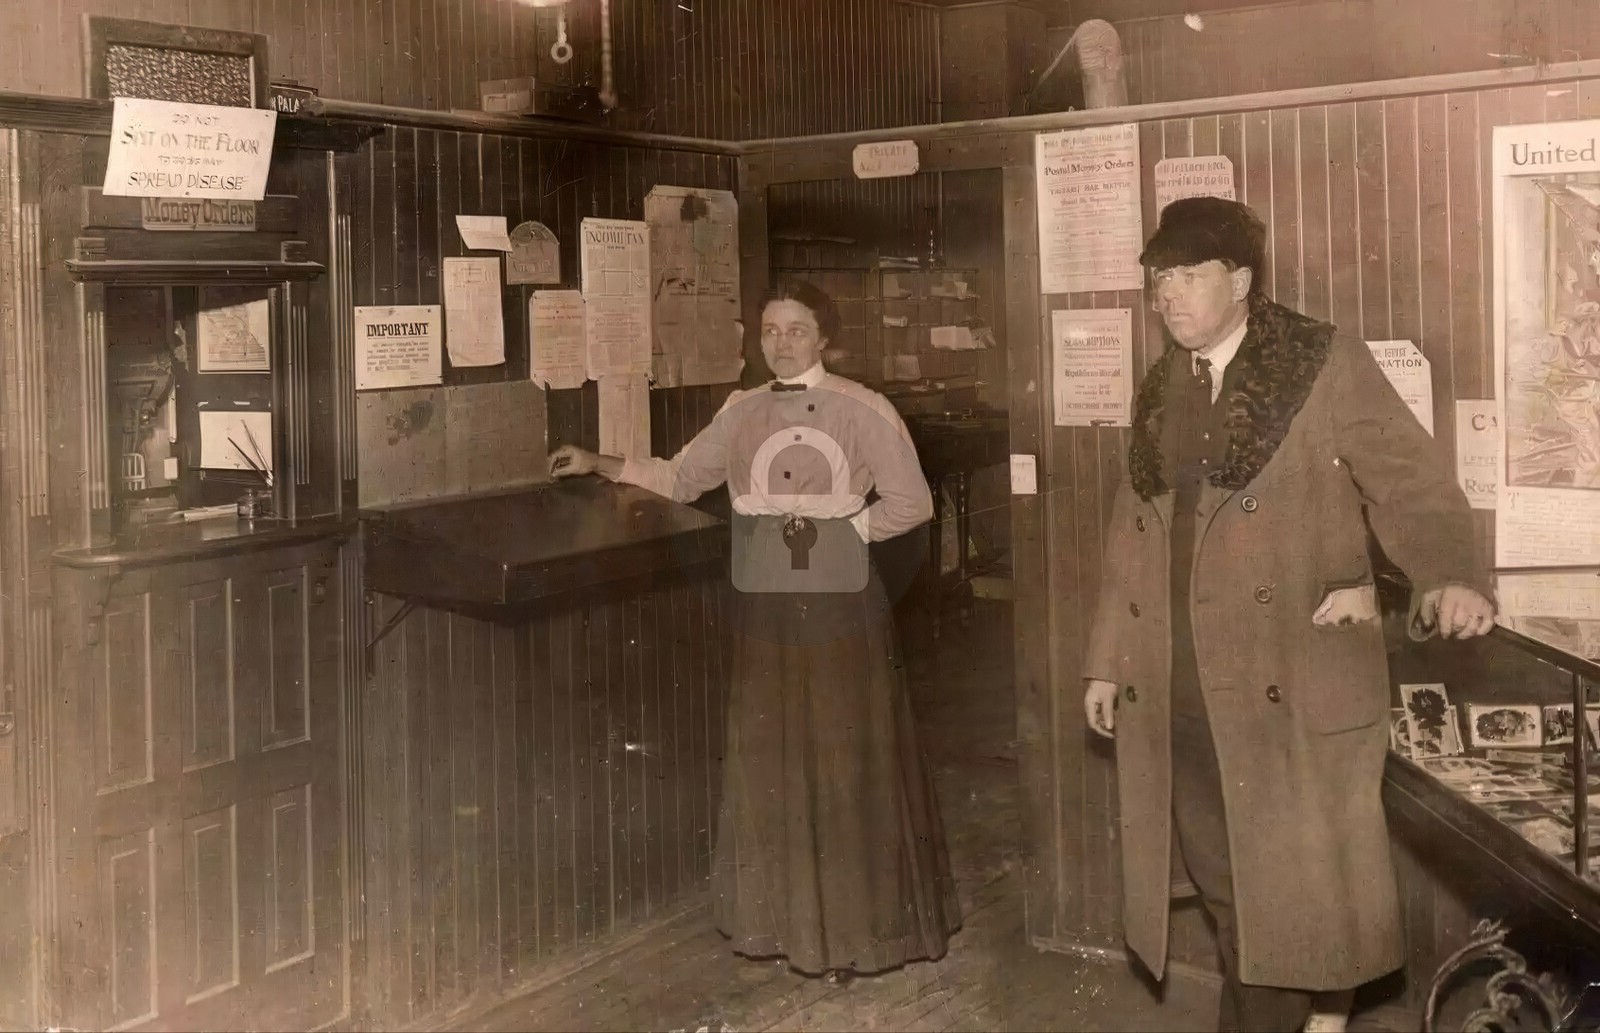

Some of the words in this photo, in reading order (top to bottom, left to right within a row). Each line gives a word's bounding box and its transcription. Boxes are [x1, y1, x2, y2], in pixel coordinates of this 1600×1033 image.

[196, 115, 221, 126] NOT
[121, 124, 156, 146] SPIT
[160, 131, 179, 148] ON
[186, 132, 213, 152] THE
[216, 132, 261, 156] FLOOR
[1510, 138, 1597, 166] United
[1071, 163, 1103, 174] Money
[1104, 159, 1135, 171] Orders
[127, 170, 183, 190] SPREAD
[186, 172, 249, 191] DISEASE
[143, 197, 201, 225] Money
[202, 198, 254, 225] Orders
[366, 322, 430, 338] IMPORTANT
